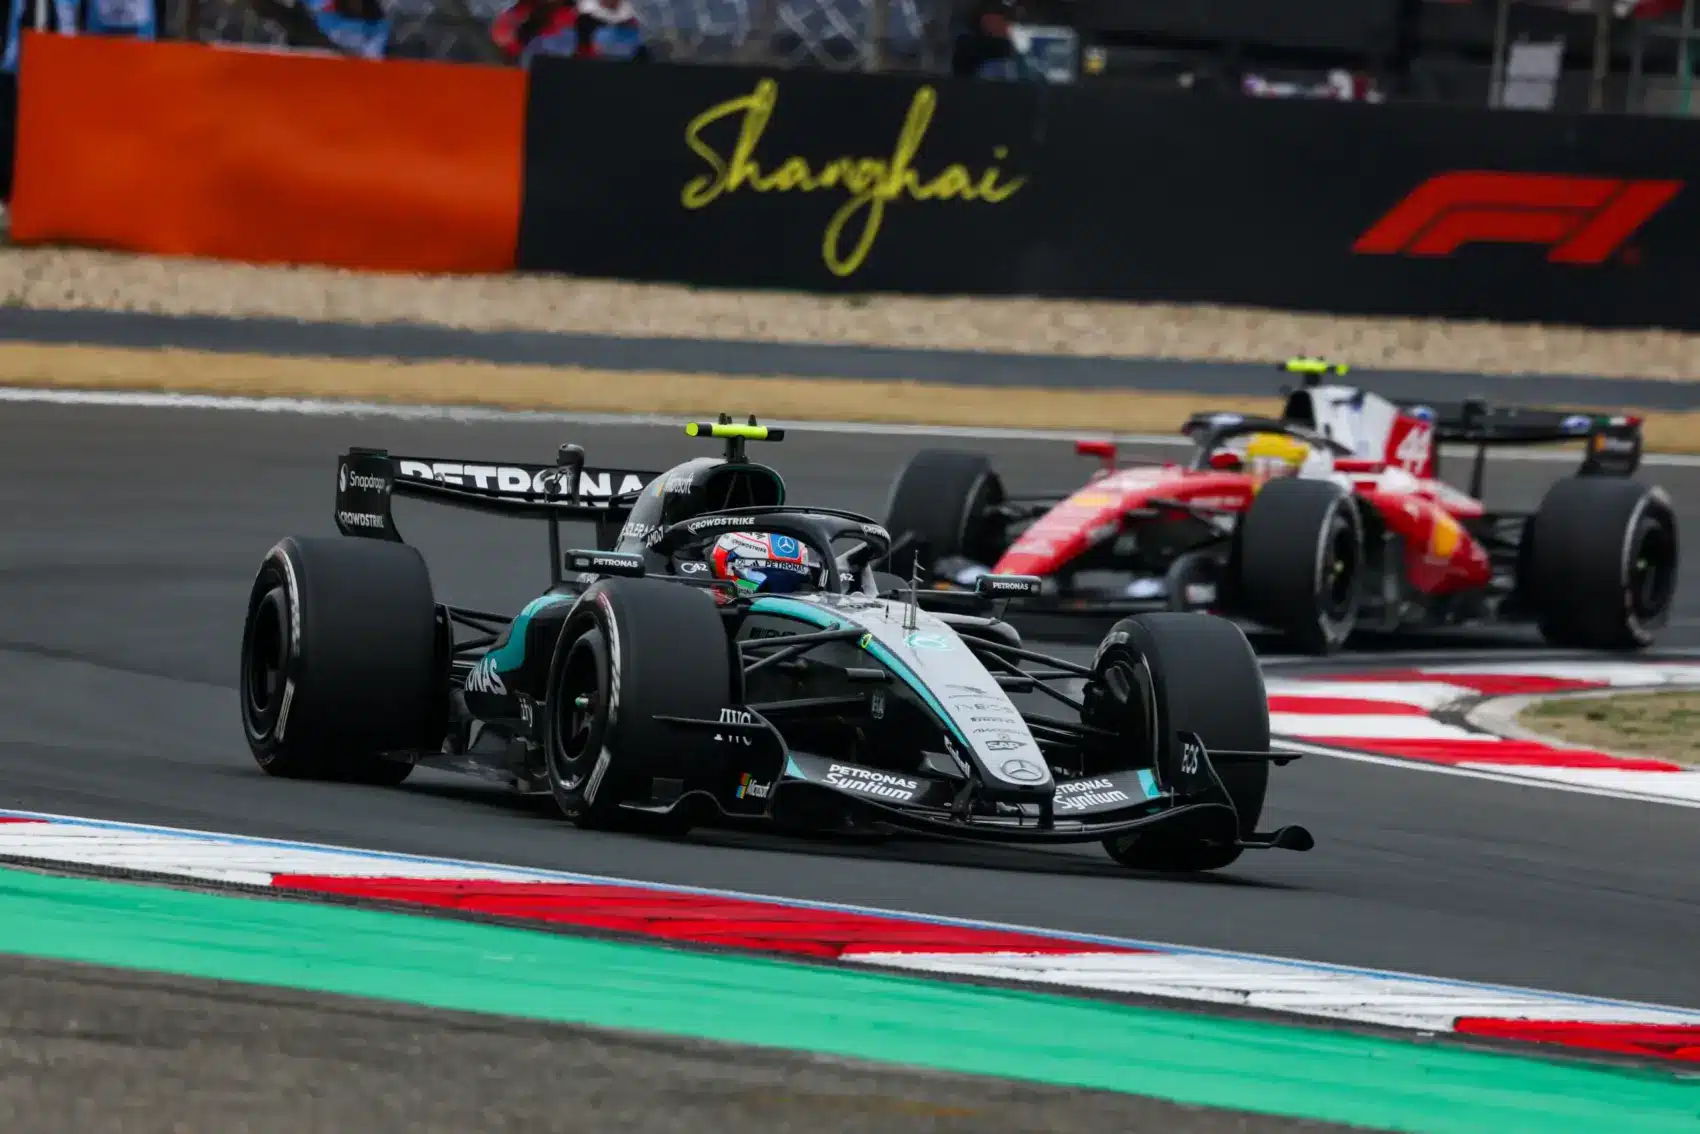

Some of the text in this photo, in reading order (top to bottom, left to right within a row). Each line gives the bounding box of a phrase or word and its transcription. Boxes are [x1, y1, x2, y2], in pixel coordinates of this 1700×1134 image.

[681, 78, 1026, 277] Shanghai
[1353, 170, 1684, 264] F1
[349, 470, 385, 494] Snapdragon
[400, 461, 644, 508] PETRONA
[340, 511, 384, 528] CROWDSTRIKE
[691, 516, 755, 530] CROWDSTRIKE
[593, 557, 639, 568] PETRONAS
[992, 581, 1029, 591] PETRONAS
[466, 658, 508, 696] ONAS
[821, 772, 914, 801] Syntium
[829, 763, 918, 790] PETRONAS
[1055, 778, 1114, 796] ETRONAS
[1053, 790, 1129, 810] Syntium
